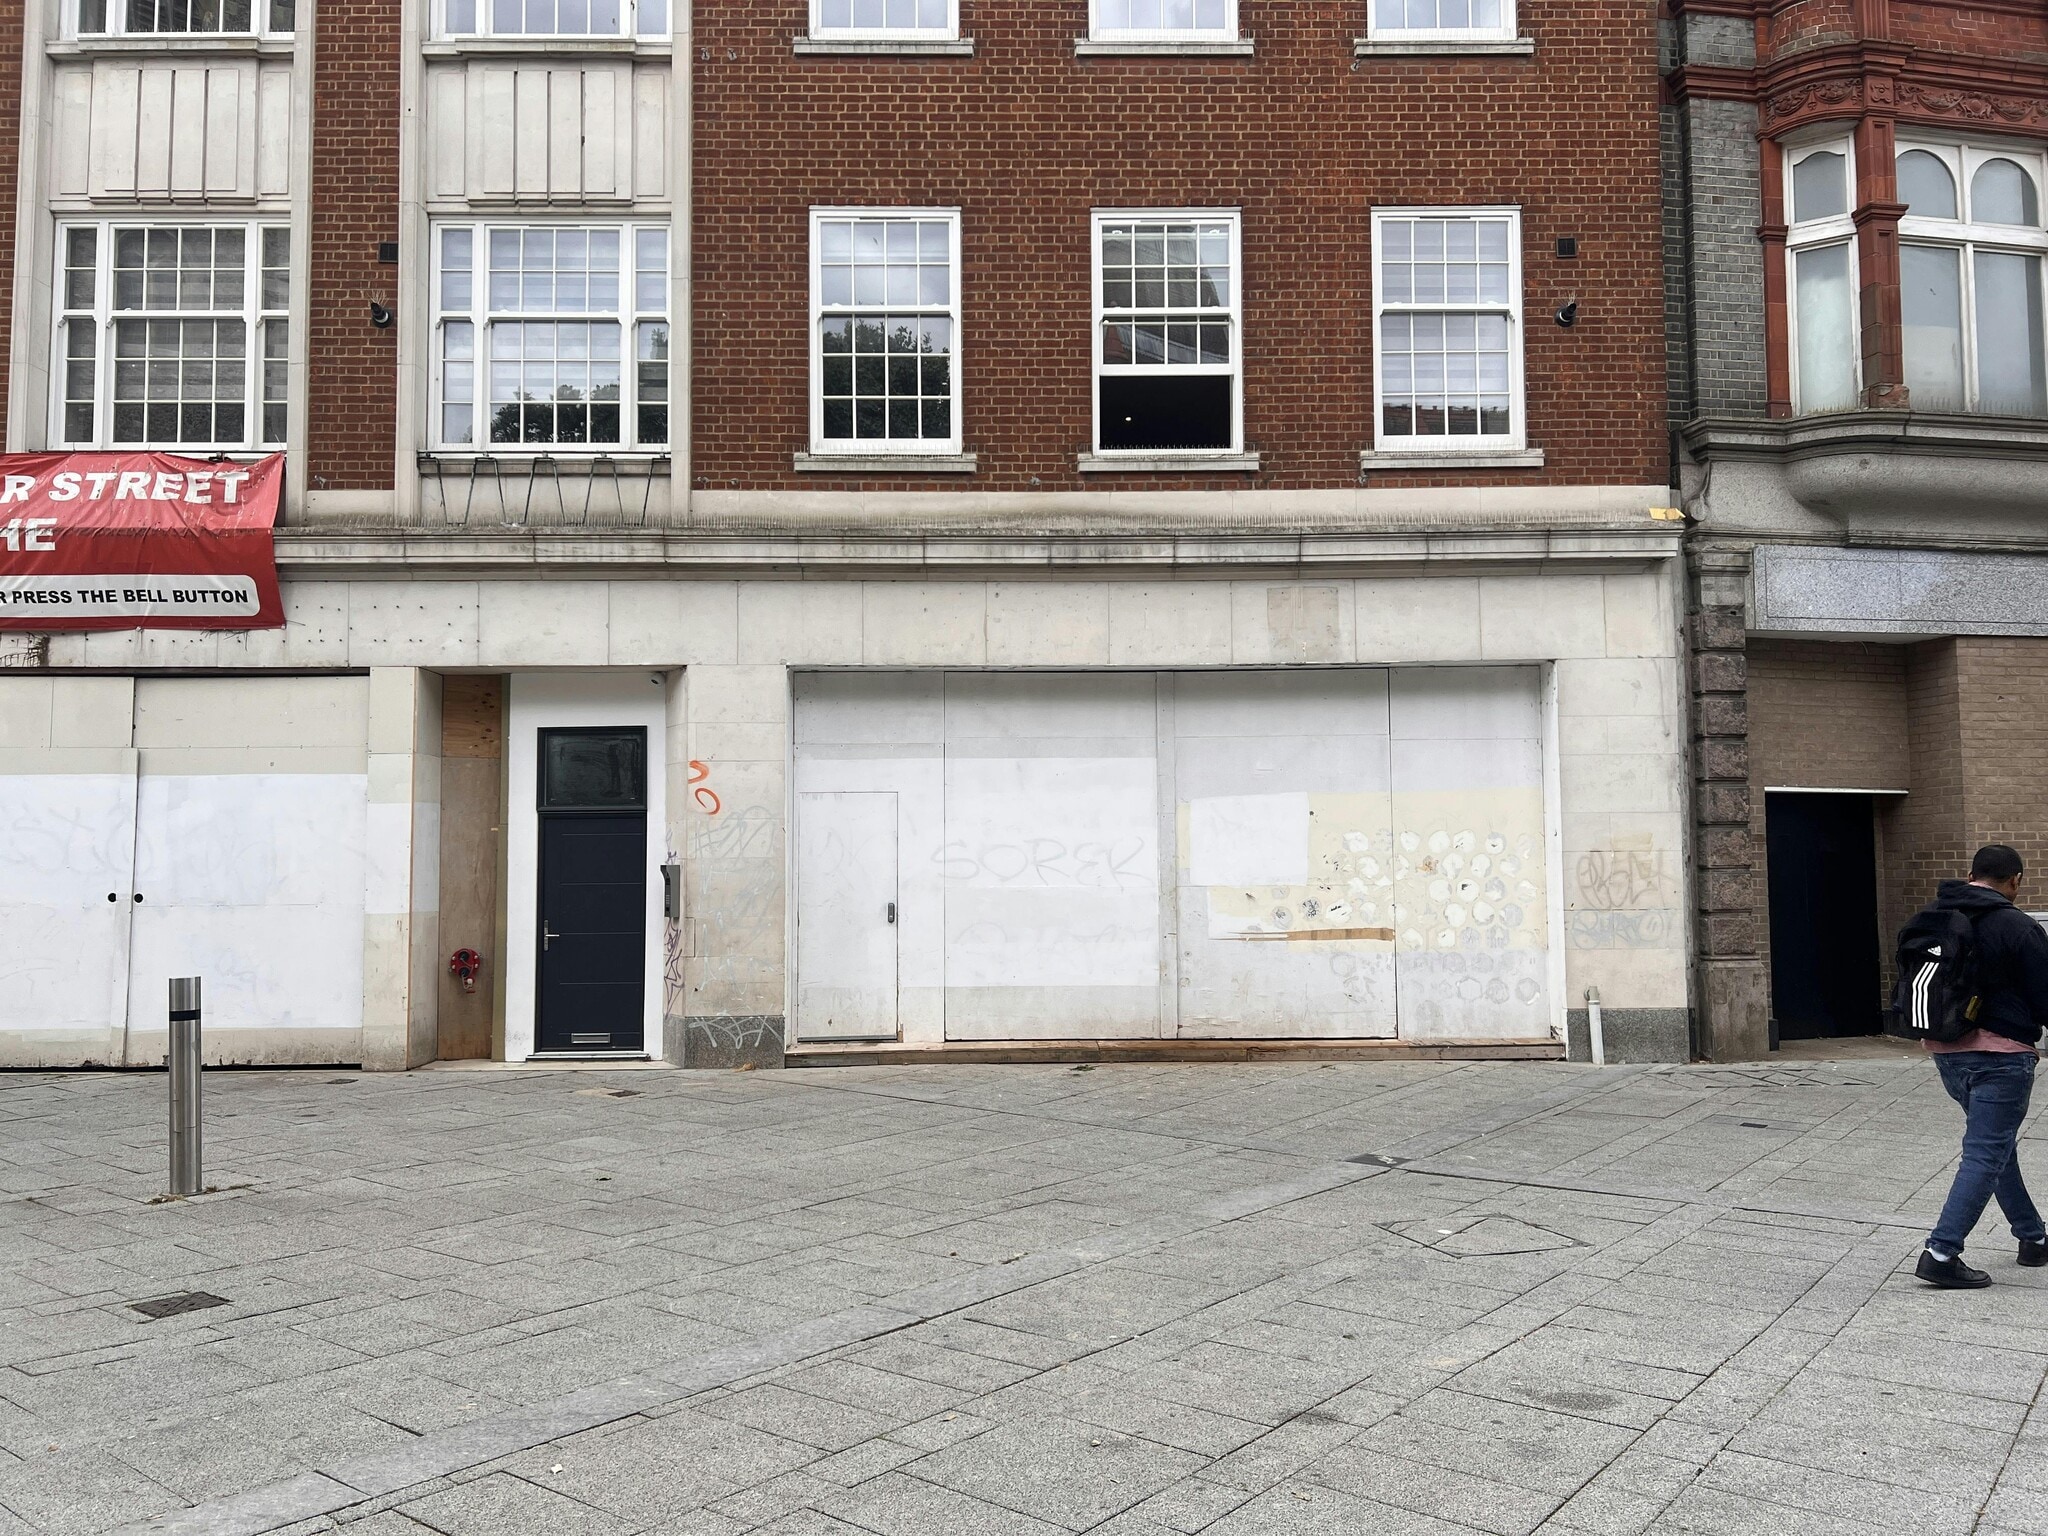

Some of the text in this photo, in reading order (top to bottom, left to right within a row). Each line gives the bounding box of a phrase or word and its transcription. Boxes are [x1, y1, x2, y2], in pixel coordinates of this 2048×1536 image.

[0, 471, 250, 504] R STREET
[12, 590, 73, 604] PRESS
[77, 589, 118, 604] THE
[123, 589, 169, 604] BELL
[172, 589, 249, 604] BUTTON
[930, 836, 1155, 892] SOREK
